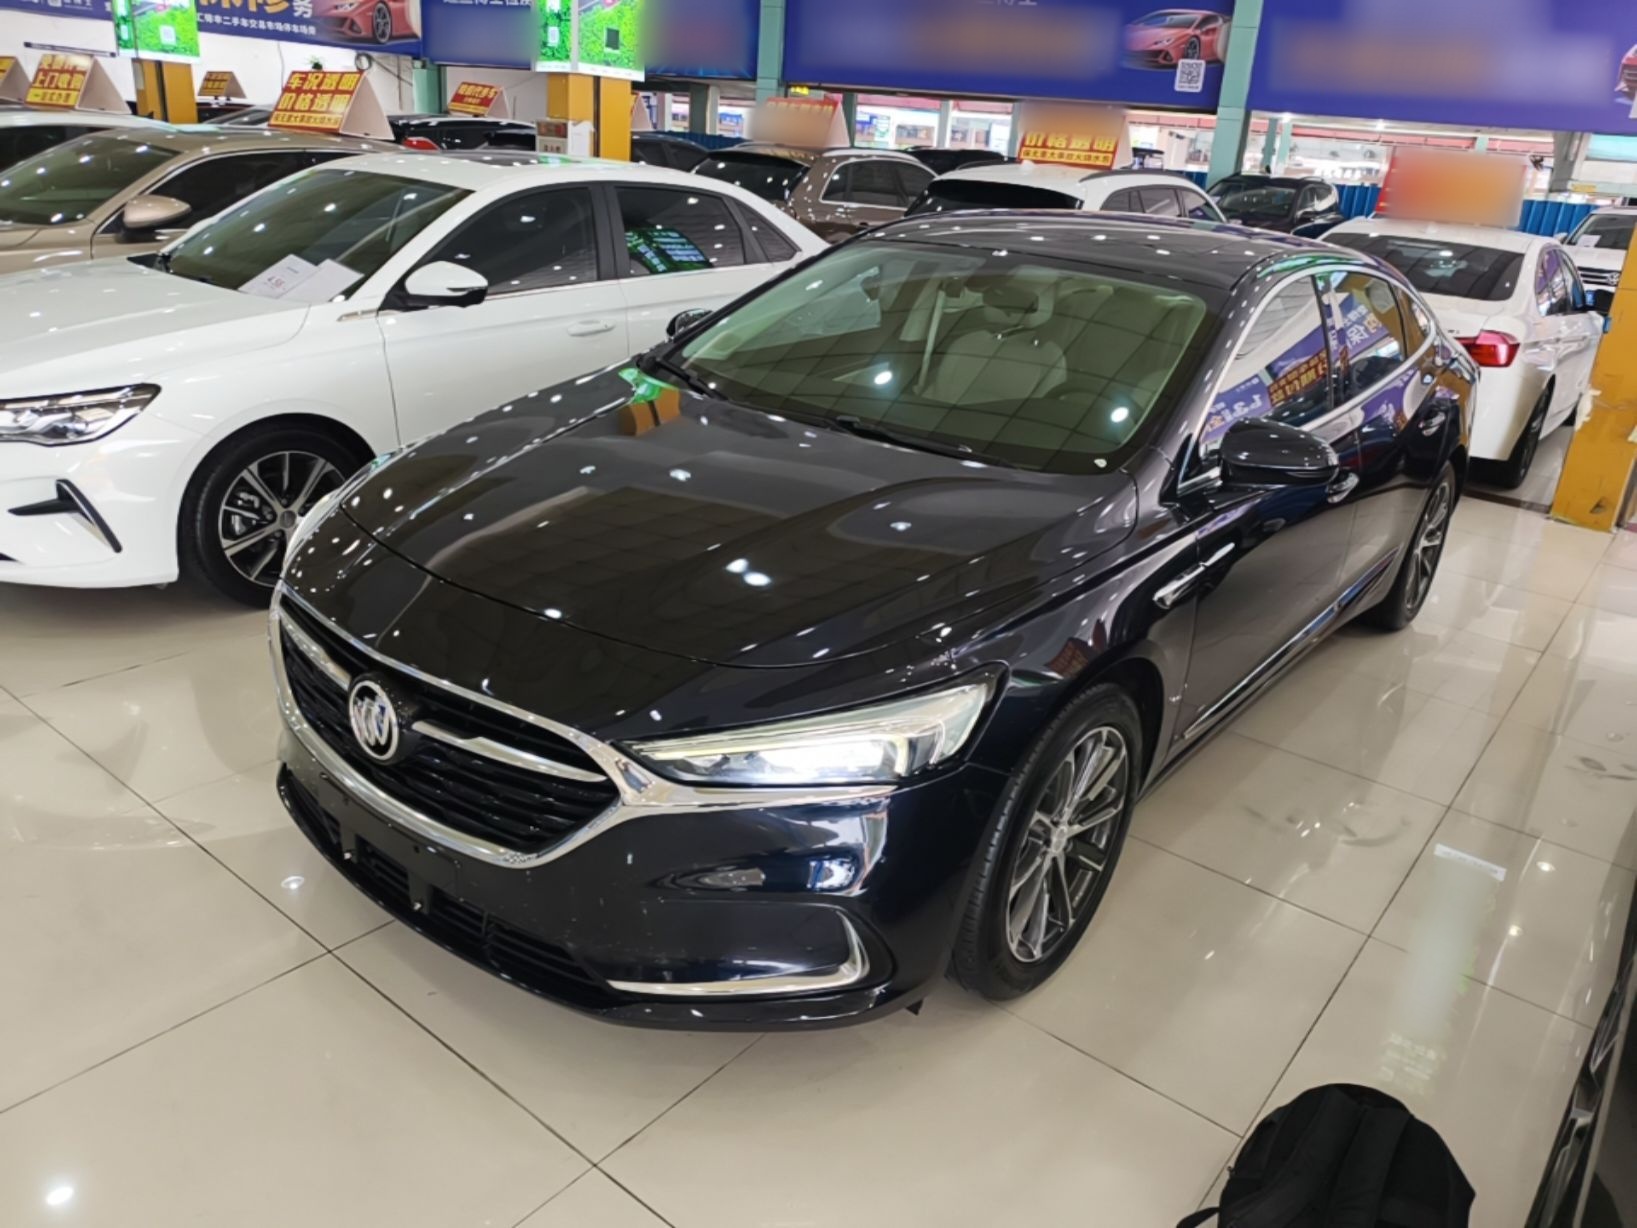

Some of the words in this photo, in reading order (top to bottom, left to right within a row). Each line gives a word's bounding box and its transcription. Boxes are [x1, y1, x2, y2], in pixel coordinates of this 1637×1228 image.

[288, 73, 360, 90] 车况透明
[278, 93, 351, 113] 价格透明
